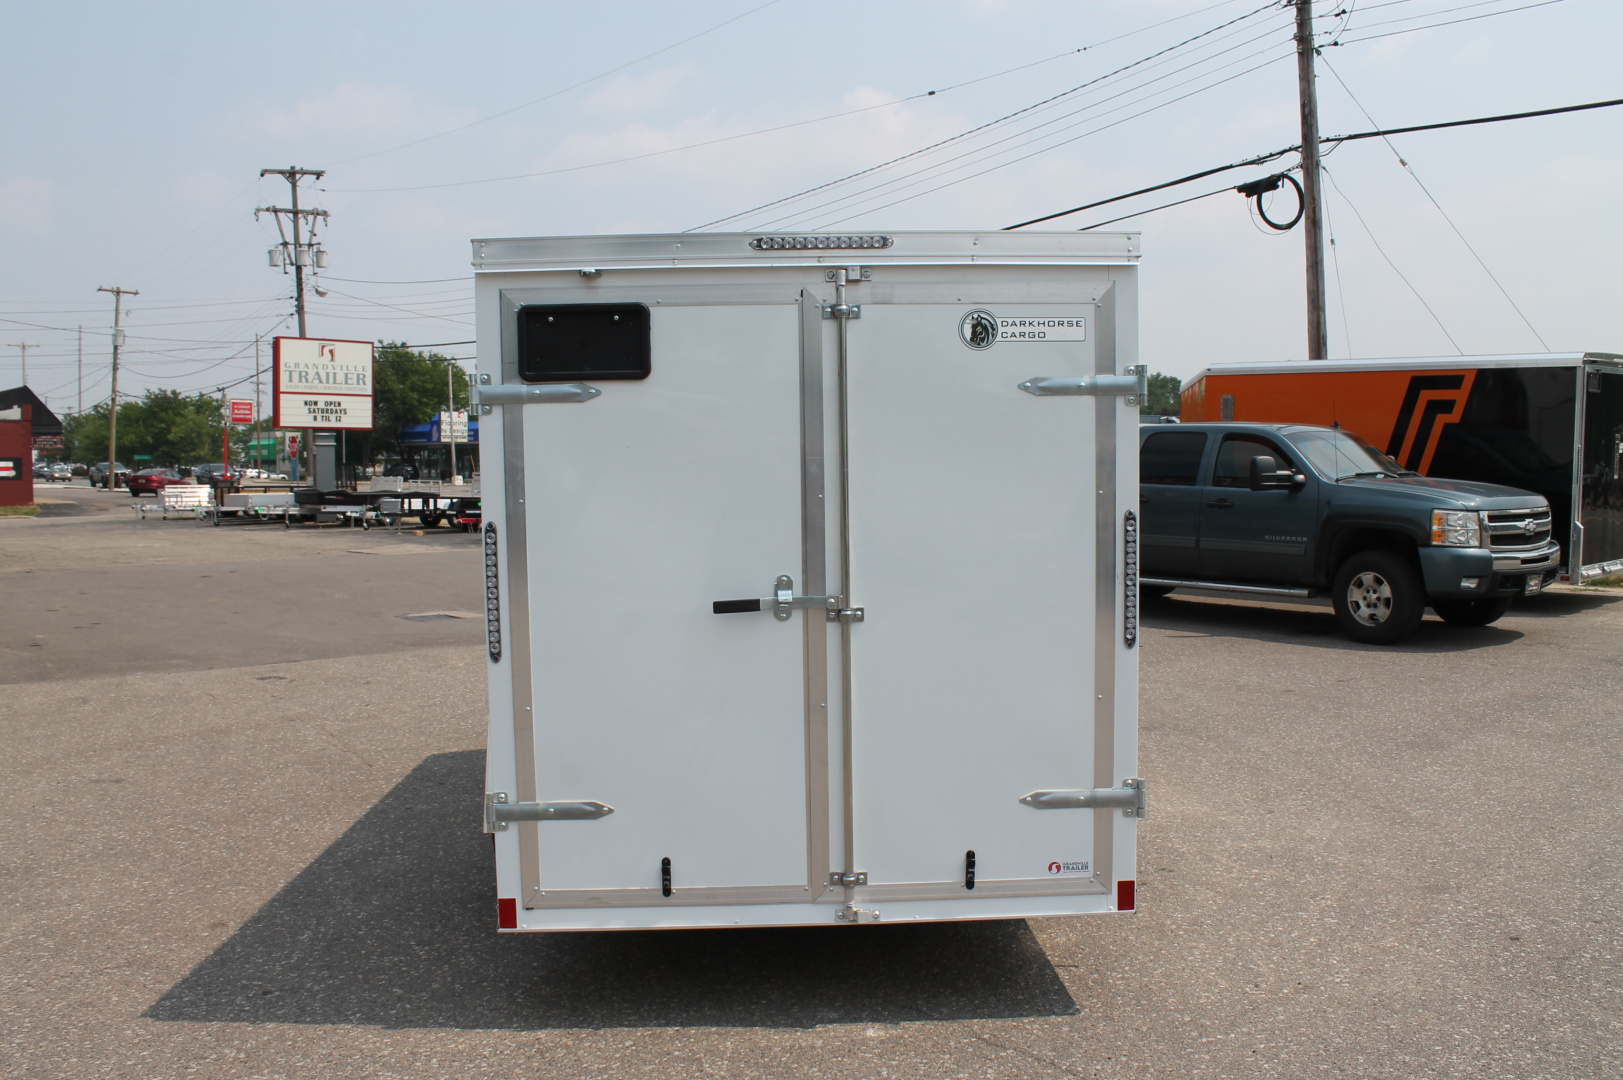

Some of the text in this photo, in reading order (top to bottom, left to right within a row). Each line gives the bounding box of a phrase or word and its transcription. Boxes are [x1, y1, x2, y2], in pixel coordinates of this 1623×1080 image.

[1001, 331, 1046, 339] CARGO
[284, 361, 367, 372] GRANDVILLE
[284, 369, 367, 386] TRAILER
[307, 407, 347, 415] SATURDAYS
